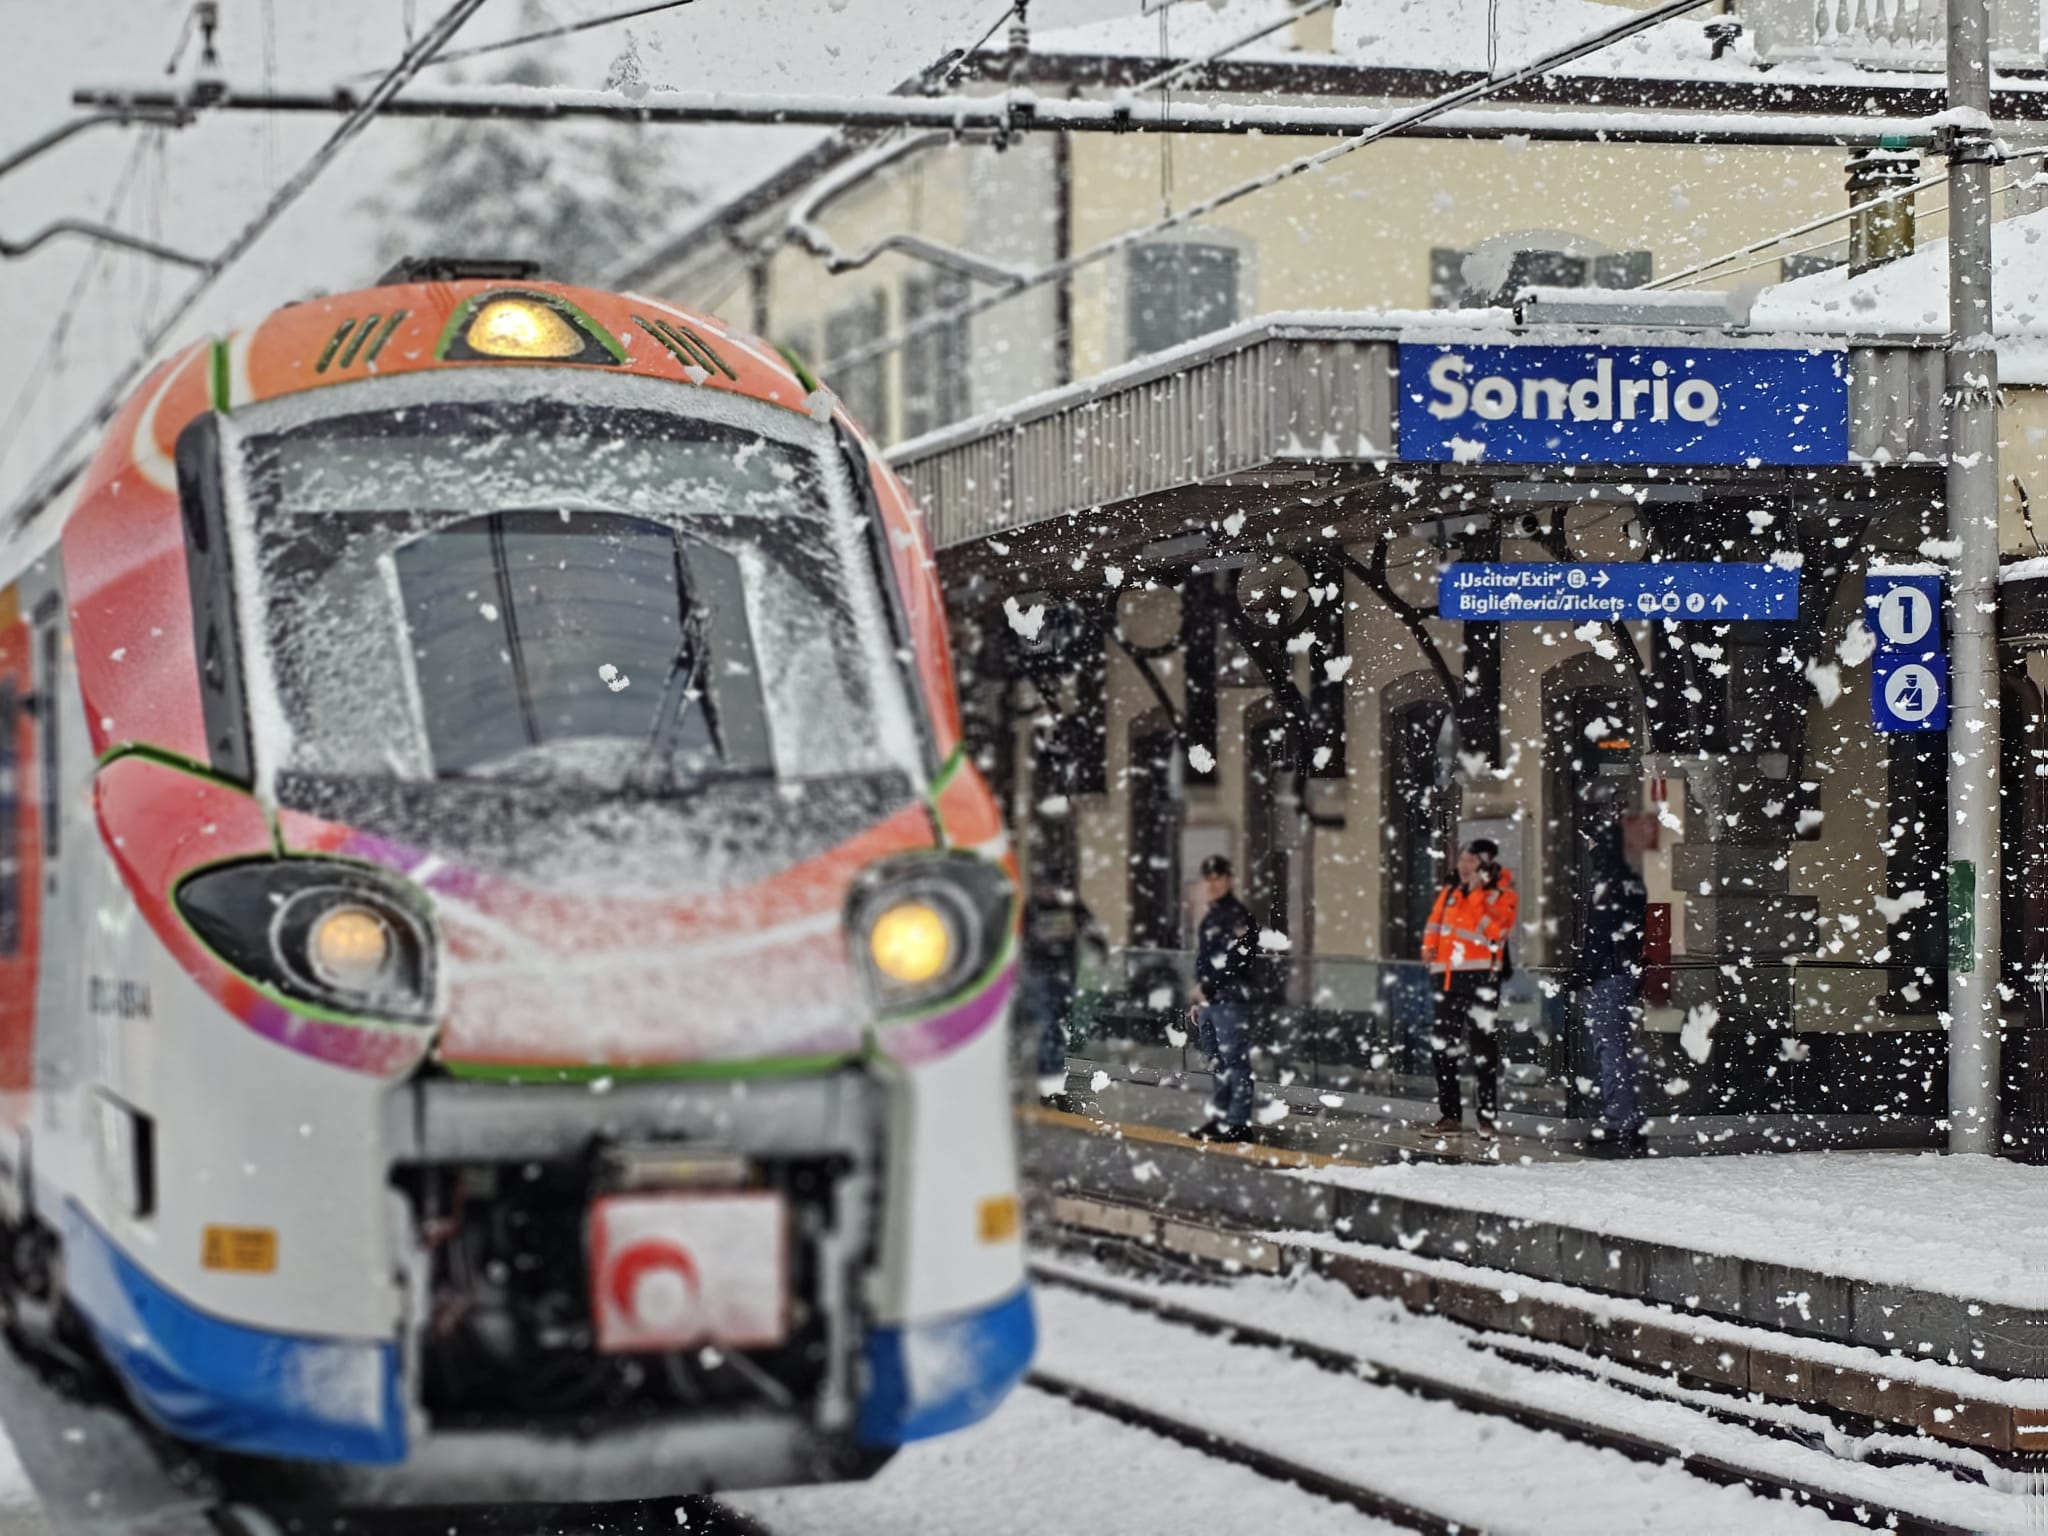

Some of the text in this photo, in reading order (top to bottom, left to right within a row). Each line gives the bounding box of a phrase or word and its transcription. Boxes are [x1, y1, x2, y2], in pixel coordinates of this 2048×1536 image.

[1427, 354, 1719, 421] Sondrio
[1460, 571, 1556, 587] Uscita/Exit
[1460, 594, 1625, 613] Biglietteria/Tickets
[1898, 596, 1914, 634] 1
